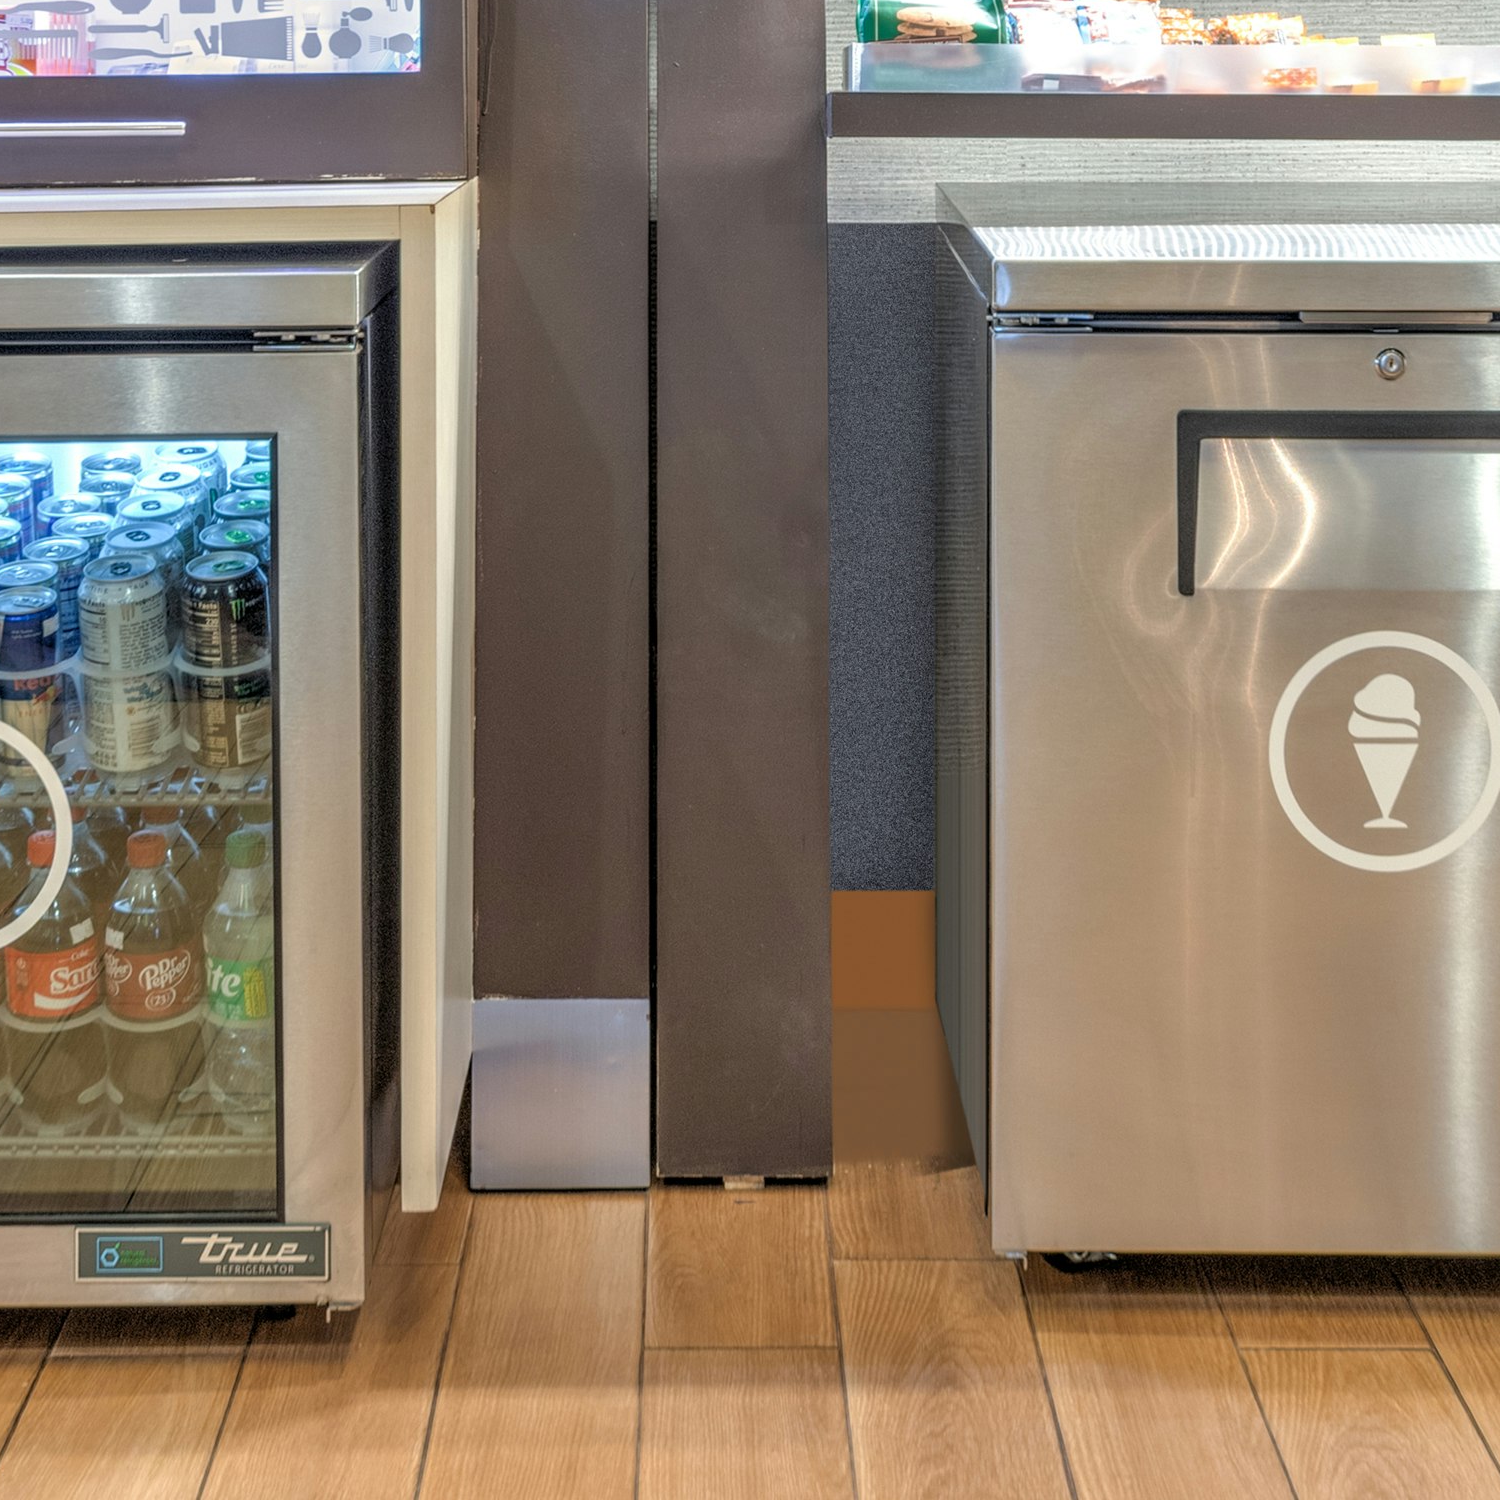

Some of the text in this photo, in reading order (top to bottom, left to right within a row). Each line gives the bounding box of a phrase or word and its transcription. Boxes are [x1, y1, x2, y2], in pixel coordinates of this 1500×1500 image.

[140, 959, 188, 991] Pepper
[159, 956, 179, 971] Dr
[181, 1233, 308, 1264] true
[215, 1264, 295, 1275] REFRIGERATOR
